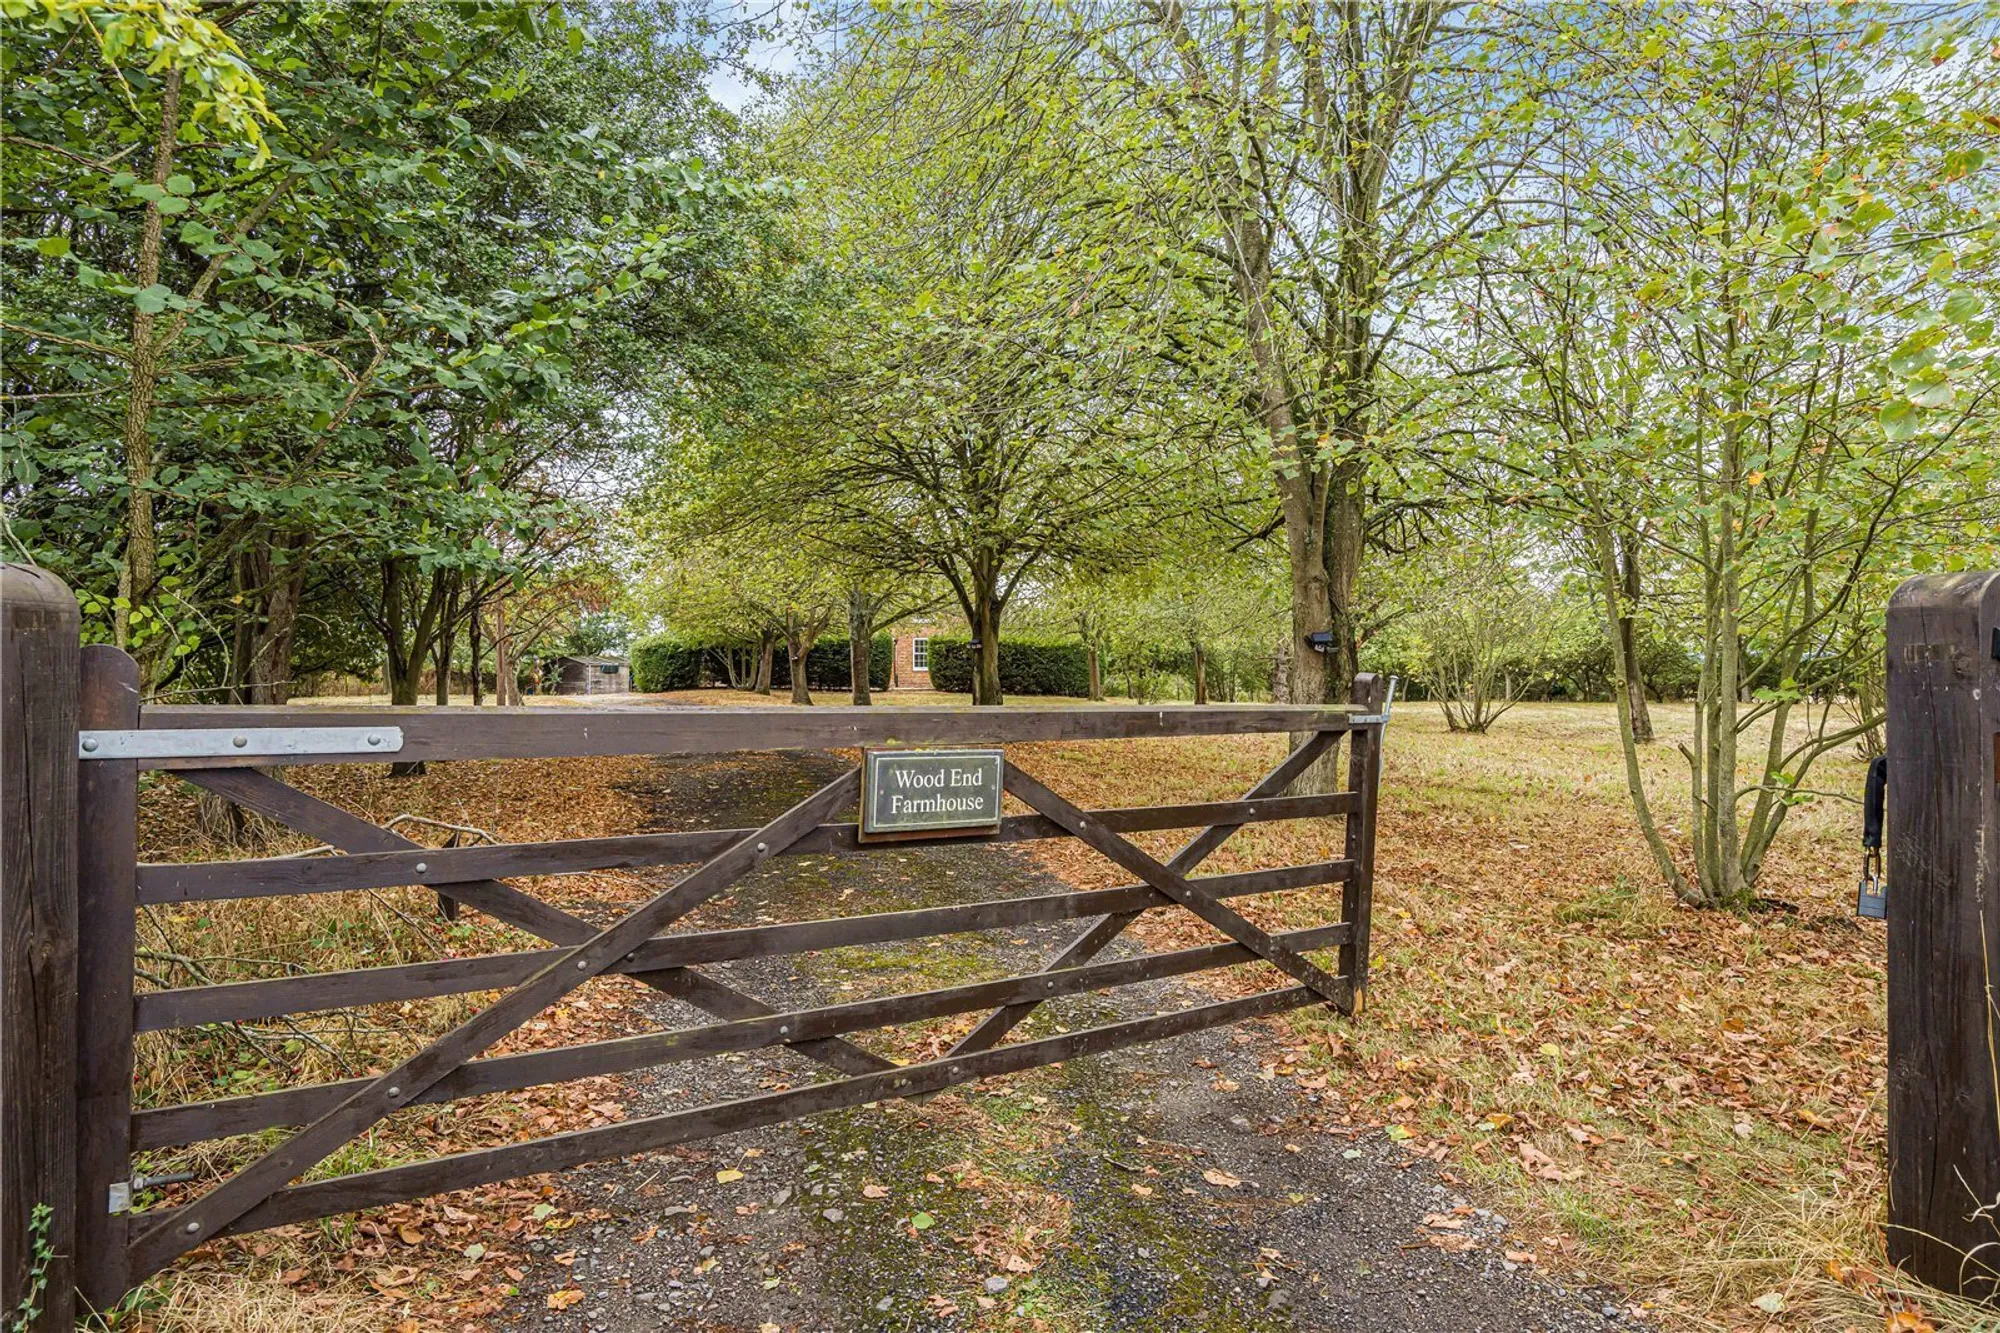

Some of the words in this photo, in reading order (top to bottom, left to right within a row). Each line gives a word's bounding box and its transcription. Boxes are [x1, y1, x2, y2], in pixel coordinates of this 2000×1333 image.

[895, 768, 944, 789] Wood
[950, 767, 983, 787] End
[890, 793, 984, 814] Farmhouse
